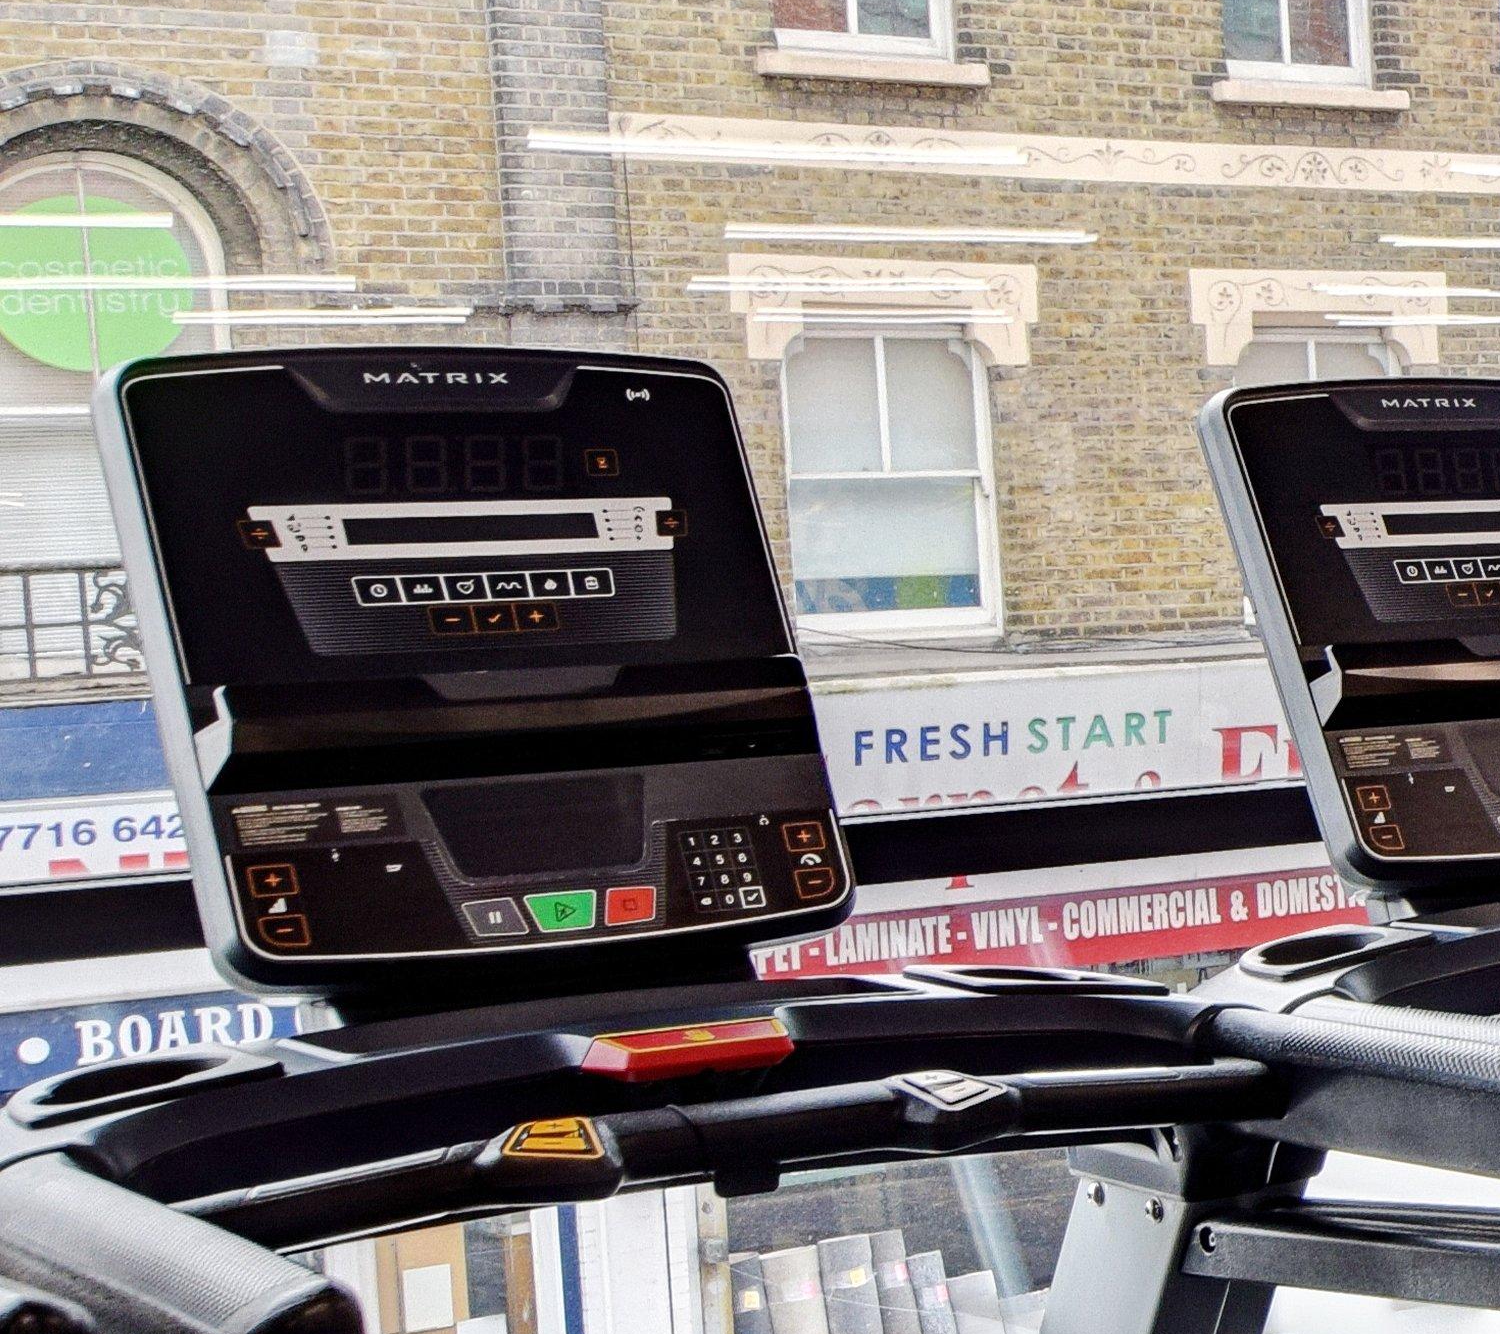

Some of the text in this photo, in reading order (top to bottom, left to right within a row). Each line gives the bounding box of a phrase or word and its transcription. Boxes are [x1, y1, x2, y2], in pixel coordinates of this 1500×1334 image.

[363, 372, 509, 384] MATRIX
[1381, 398, 1477, 408] MATRIX
[854, 721, 1009, 766] FRESH
[1026, 709, 1173, 754] START
[112, 813, 187, 843] 642
[825, 915, 952, 966] LAMINATE
[970, 905, 1044, 951] VINYL
[1062, 888, 1222, 941] COMMERCIAL
[1230, 889, 1248, 922] &
[1256, 873, 1366, 918] DOMEST
[75, 1003, 274, 1067] BOARD
